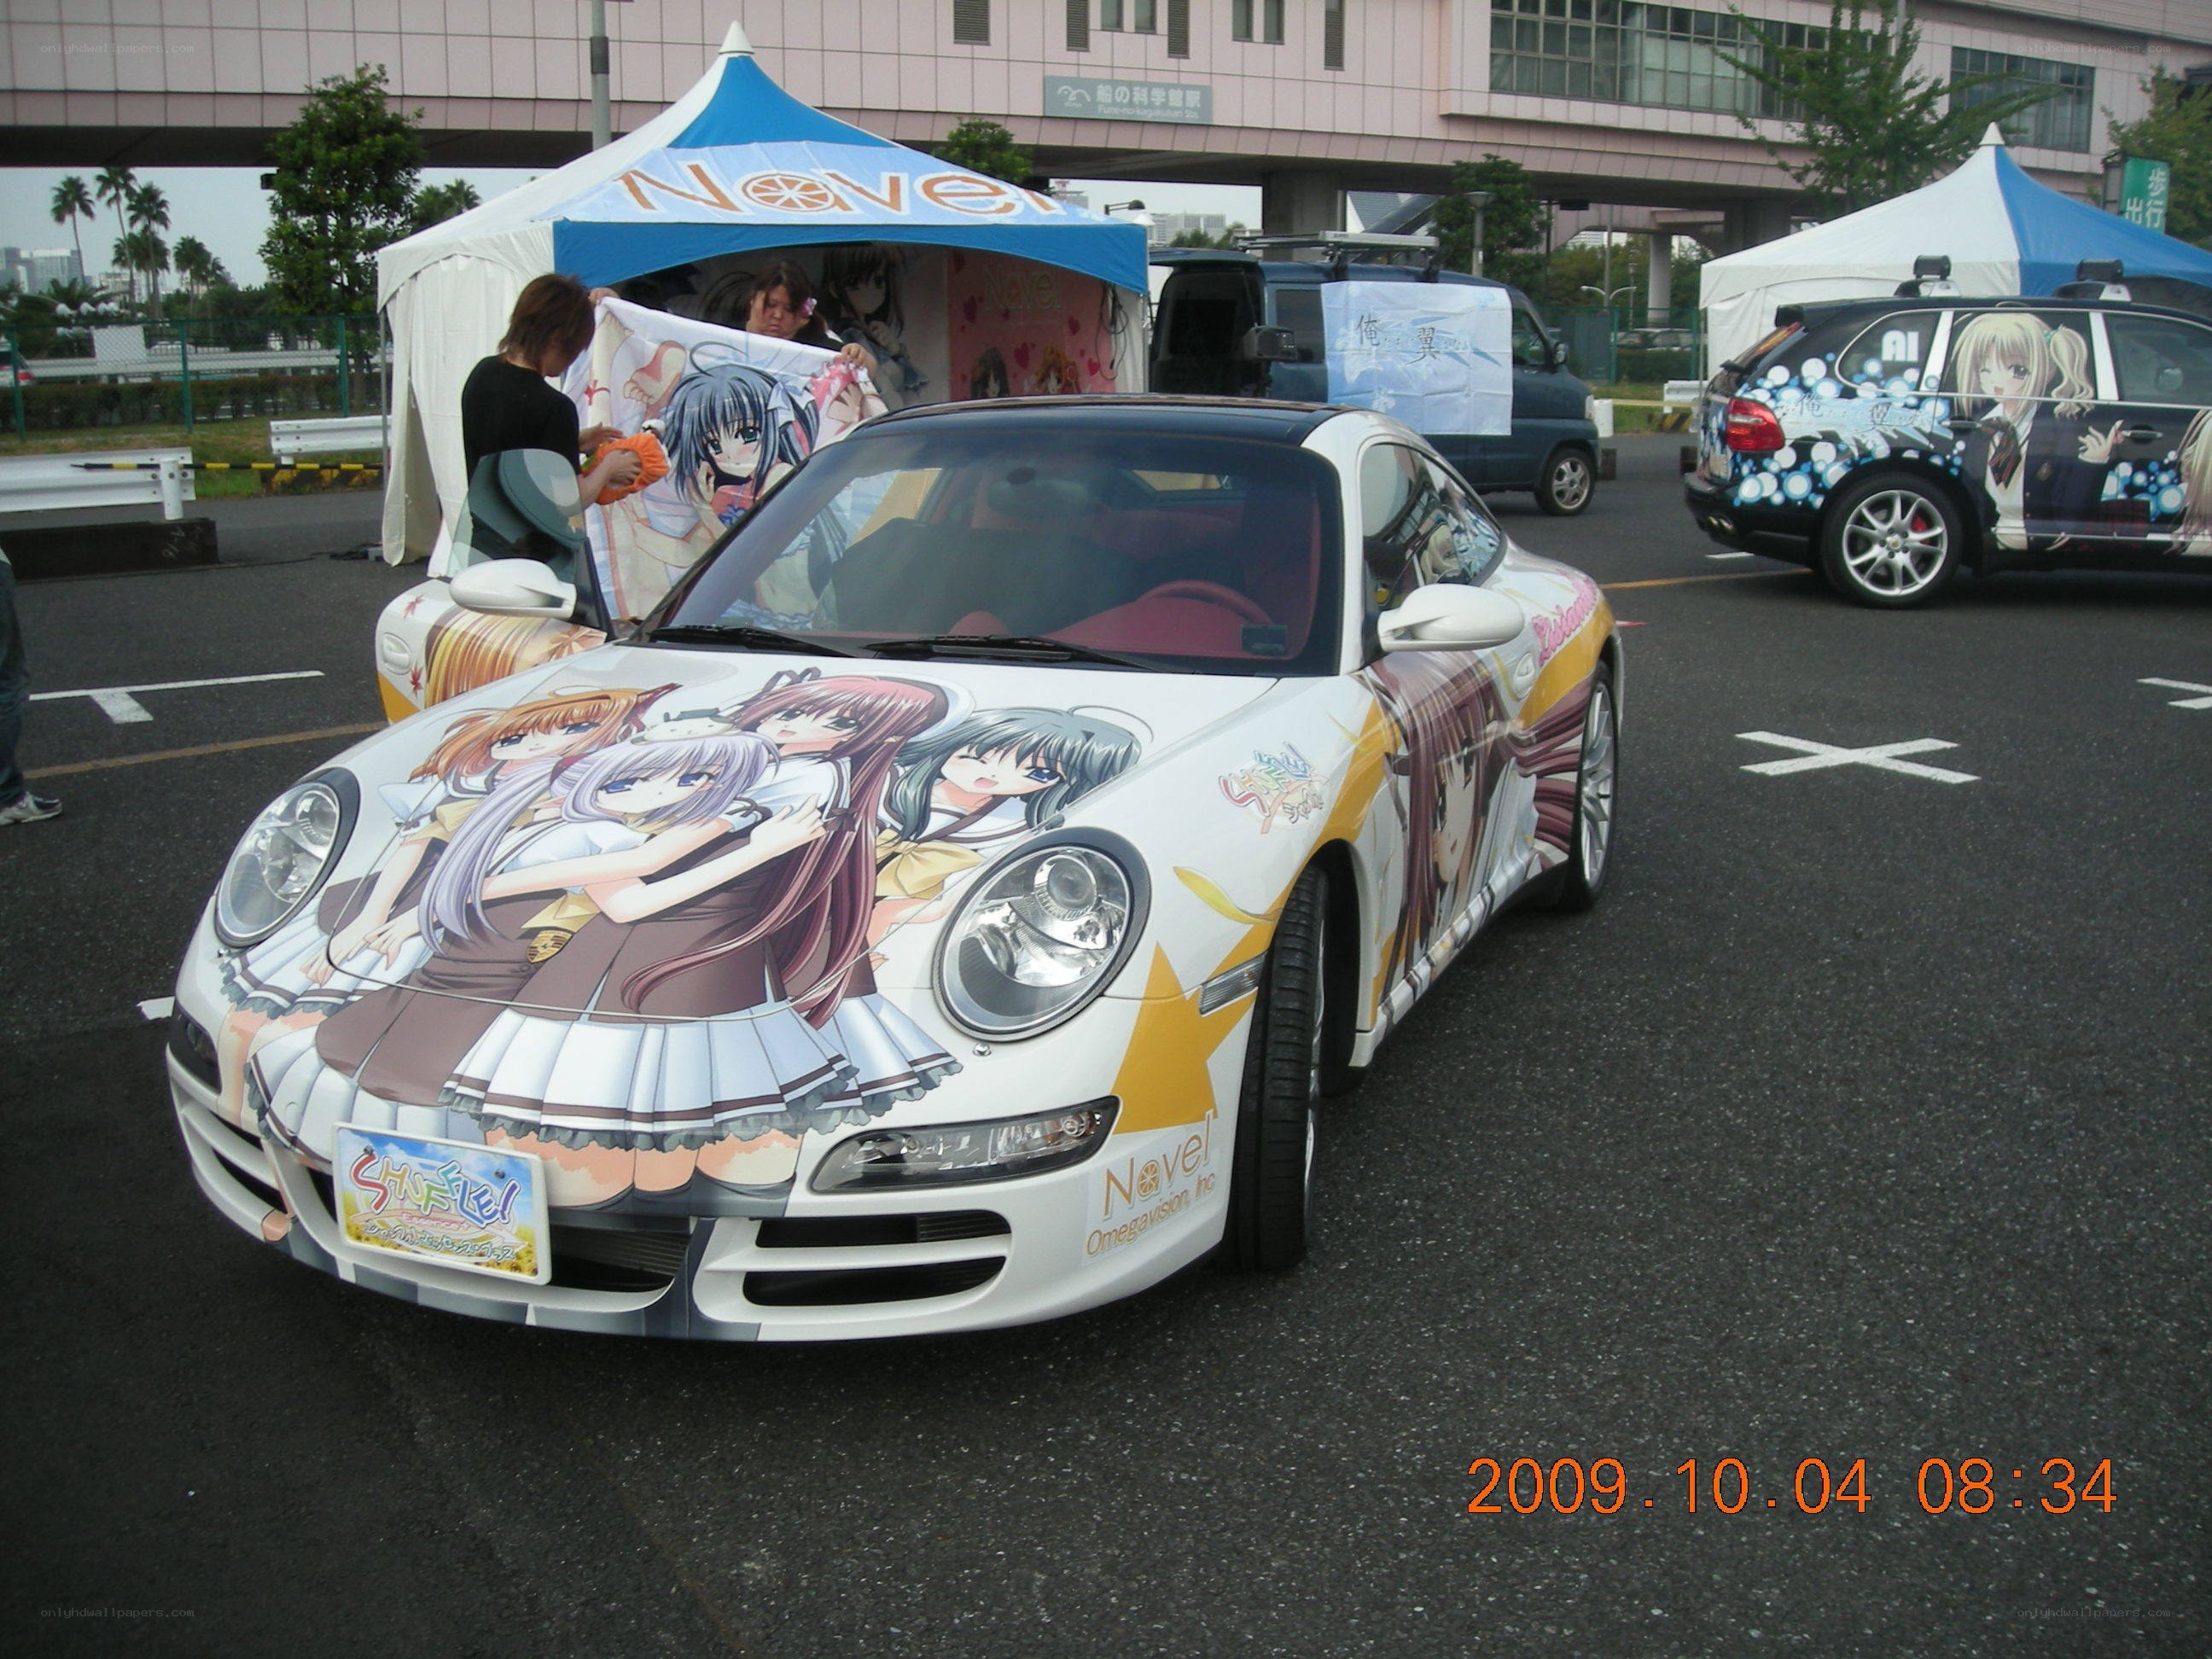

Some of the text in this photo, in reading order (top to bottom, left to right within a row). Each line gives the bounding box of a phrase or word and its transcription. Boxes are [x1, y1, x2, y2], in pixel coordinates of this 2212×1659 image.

[1096, 84, 1201, 108] 船の科学館駅
[613, 162, 1062, 215] Navel
[351, 1152, 521, 1229] SHUFFLE!
[1103, 1109, 1214, 1220] Navel
